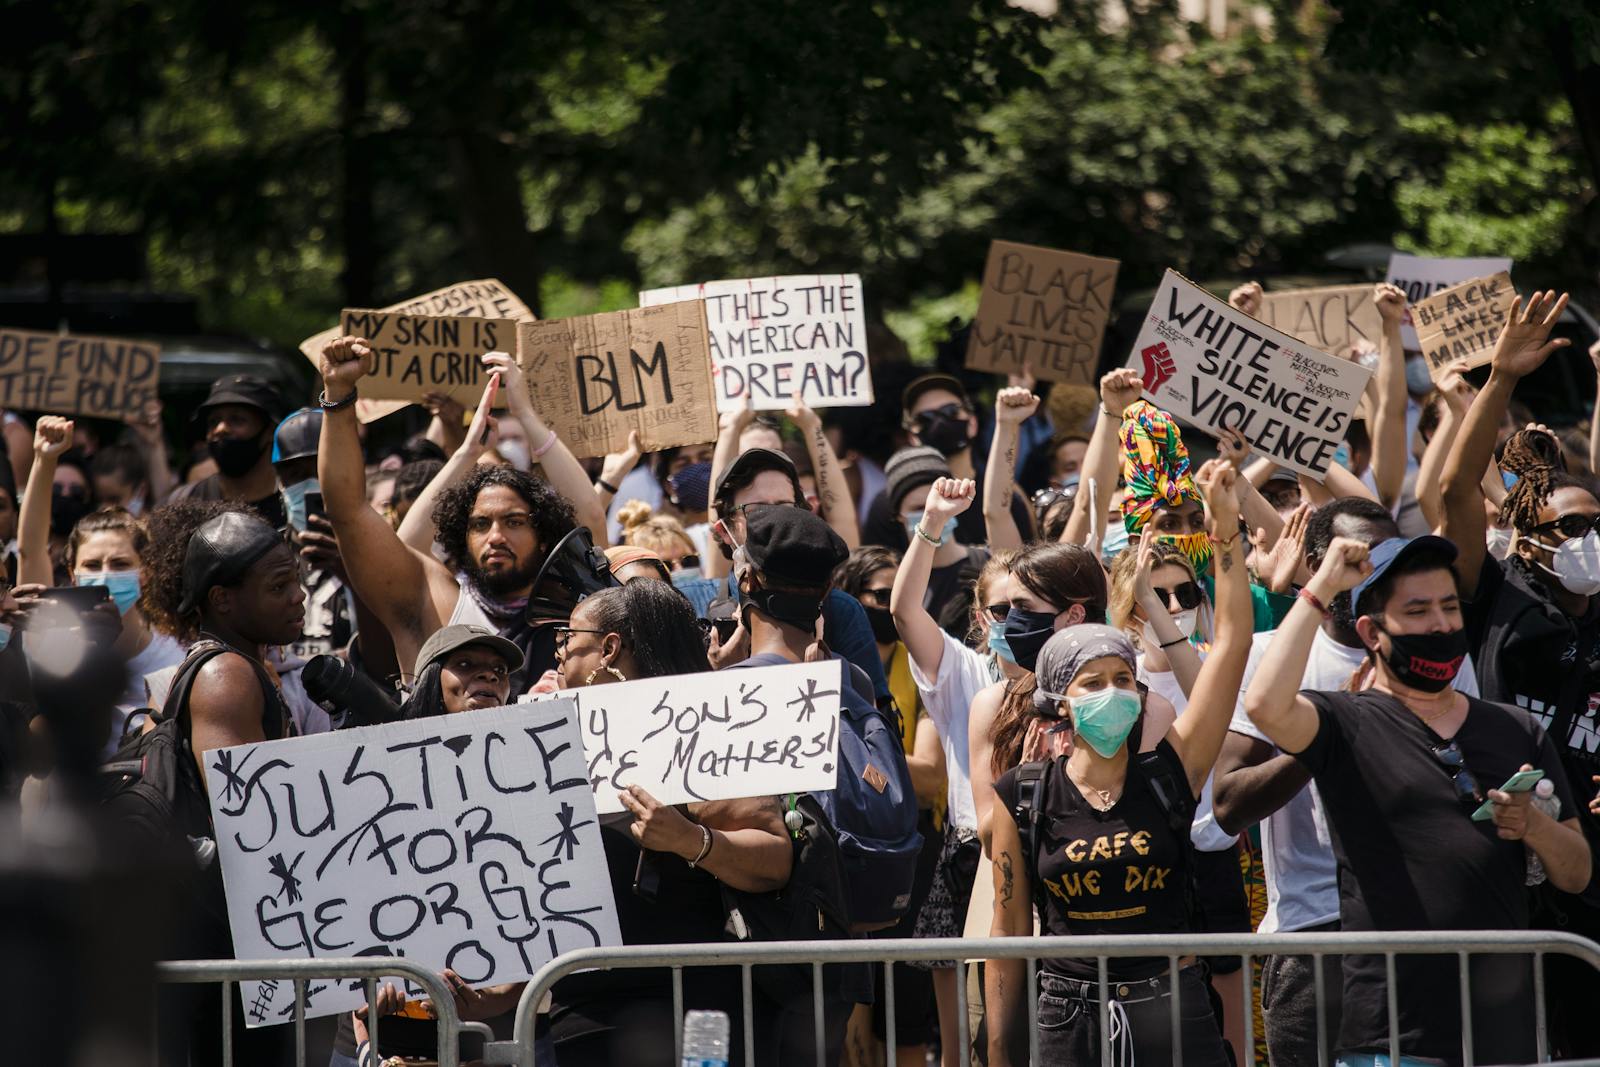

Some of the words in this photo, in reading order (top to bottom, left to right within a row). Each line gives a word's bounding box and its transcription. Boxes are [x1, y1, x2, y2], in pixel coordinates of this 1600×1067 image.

[706, 287, 789, 324] THIS
[795, 284, 856, 316] THE
[991, 252, 1113, 312] BLACK
[1418, 279, 1502, 327] BLACK
[345, 313, 389, 341] MY
[394, 317, 459, 348] SKIN
[474, 321, 498, 350] IS
[709, 321, 854, 359] AMERICAN
[1008, 296, 1097, 342] LIVES
[1168, 286, 1280, 373] WHITE
[1441, 301, 1504, 338] LIVES
[401, 354, 423, 386] A
[722, 350, 866, 399] DREAM?
[969, 320, 1095, 382] MATTER
[0, 371, 67, 410] THE
[575, 341, 674, 416] BLM
[1197, 349, 1318, 424] SILENCE
[1314, 406, 1348, 433] IS
[1190, 376, 1341, 474] VIOLENCE
[642, 683, 767, 742] SON'S
[316, 803, 536, 881] FOR
[1064, 830, 1151, 863] CAFE
[1125, 865, 1171, 893] DIX
[256, 859, 602, 958] GEORGE
